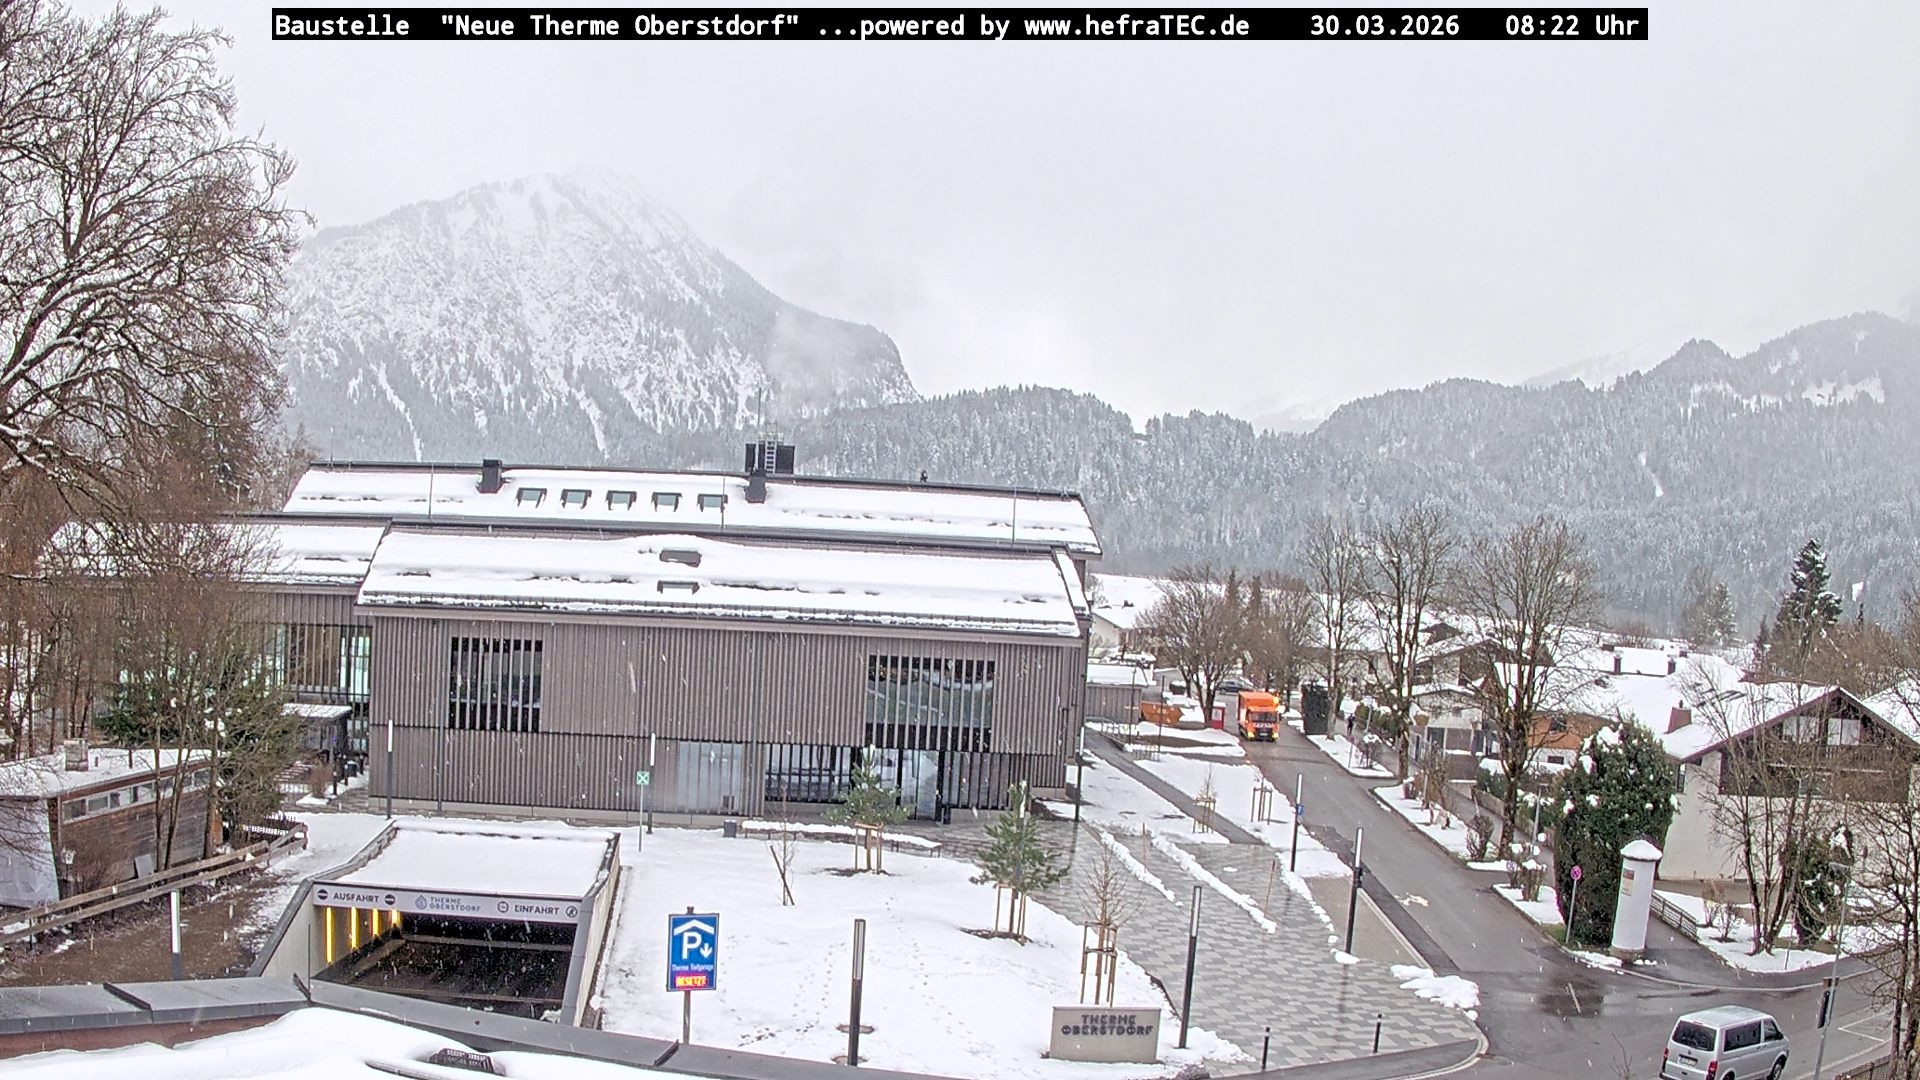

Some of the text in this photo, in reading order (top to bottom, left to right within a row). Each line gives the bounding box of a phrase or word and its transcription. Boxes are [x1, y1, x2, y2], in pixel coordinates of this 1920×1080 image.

[333, 892, 380, 904] AUSFAHRT
[514, 904, 560, 915] EINFAHRT
[682, 932, 702, 960] P
[1081, 1014, 1137, 1026] THERME
[1061, 1025, 1154, 1036] OBERSTDORF
